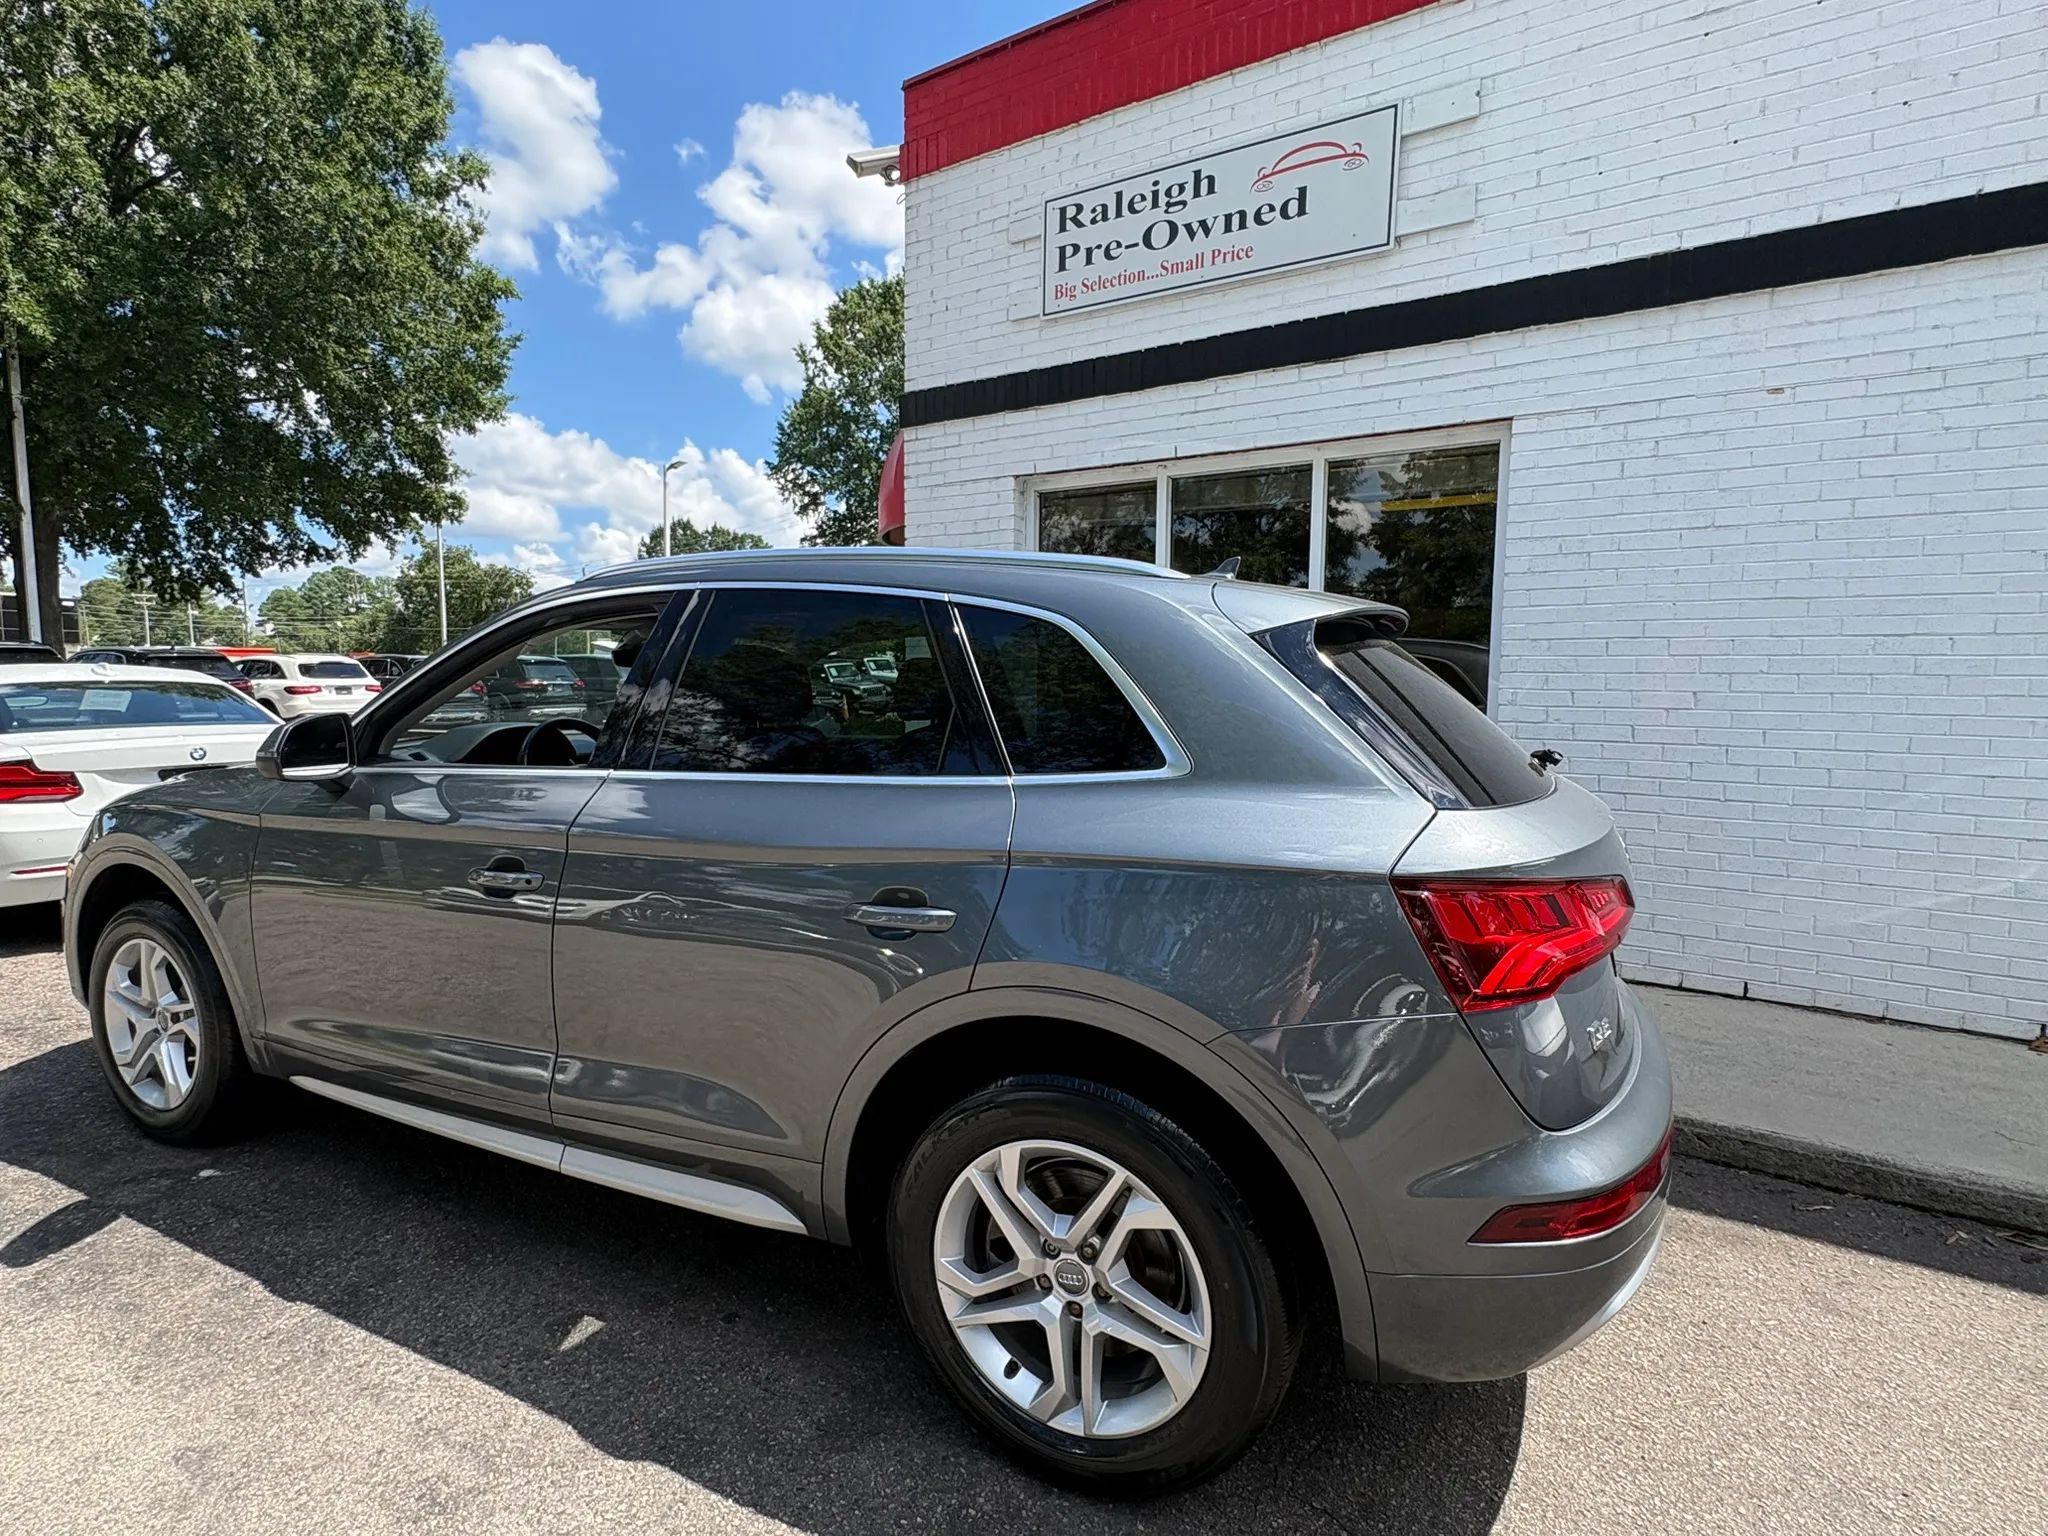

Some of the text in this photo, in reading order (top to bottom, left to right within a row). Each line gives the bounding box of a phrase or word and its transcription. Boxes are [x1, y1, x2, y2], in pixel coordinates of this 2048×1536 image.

[1055, 186, 1309, 274] Pre-Owned
[1056, 169, 1217, 235] Raleigh
[1054, 283, 1077, 301] Big
[1210, 244, 1254, 266] Price
